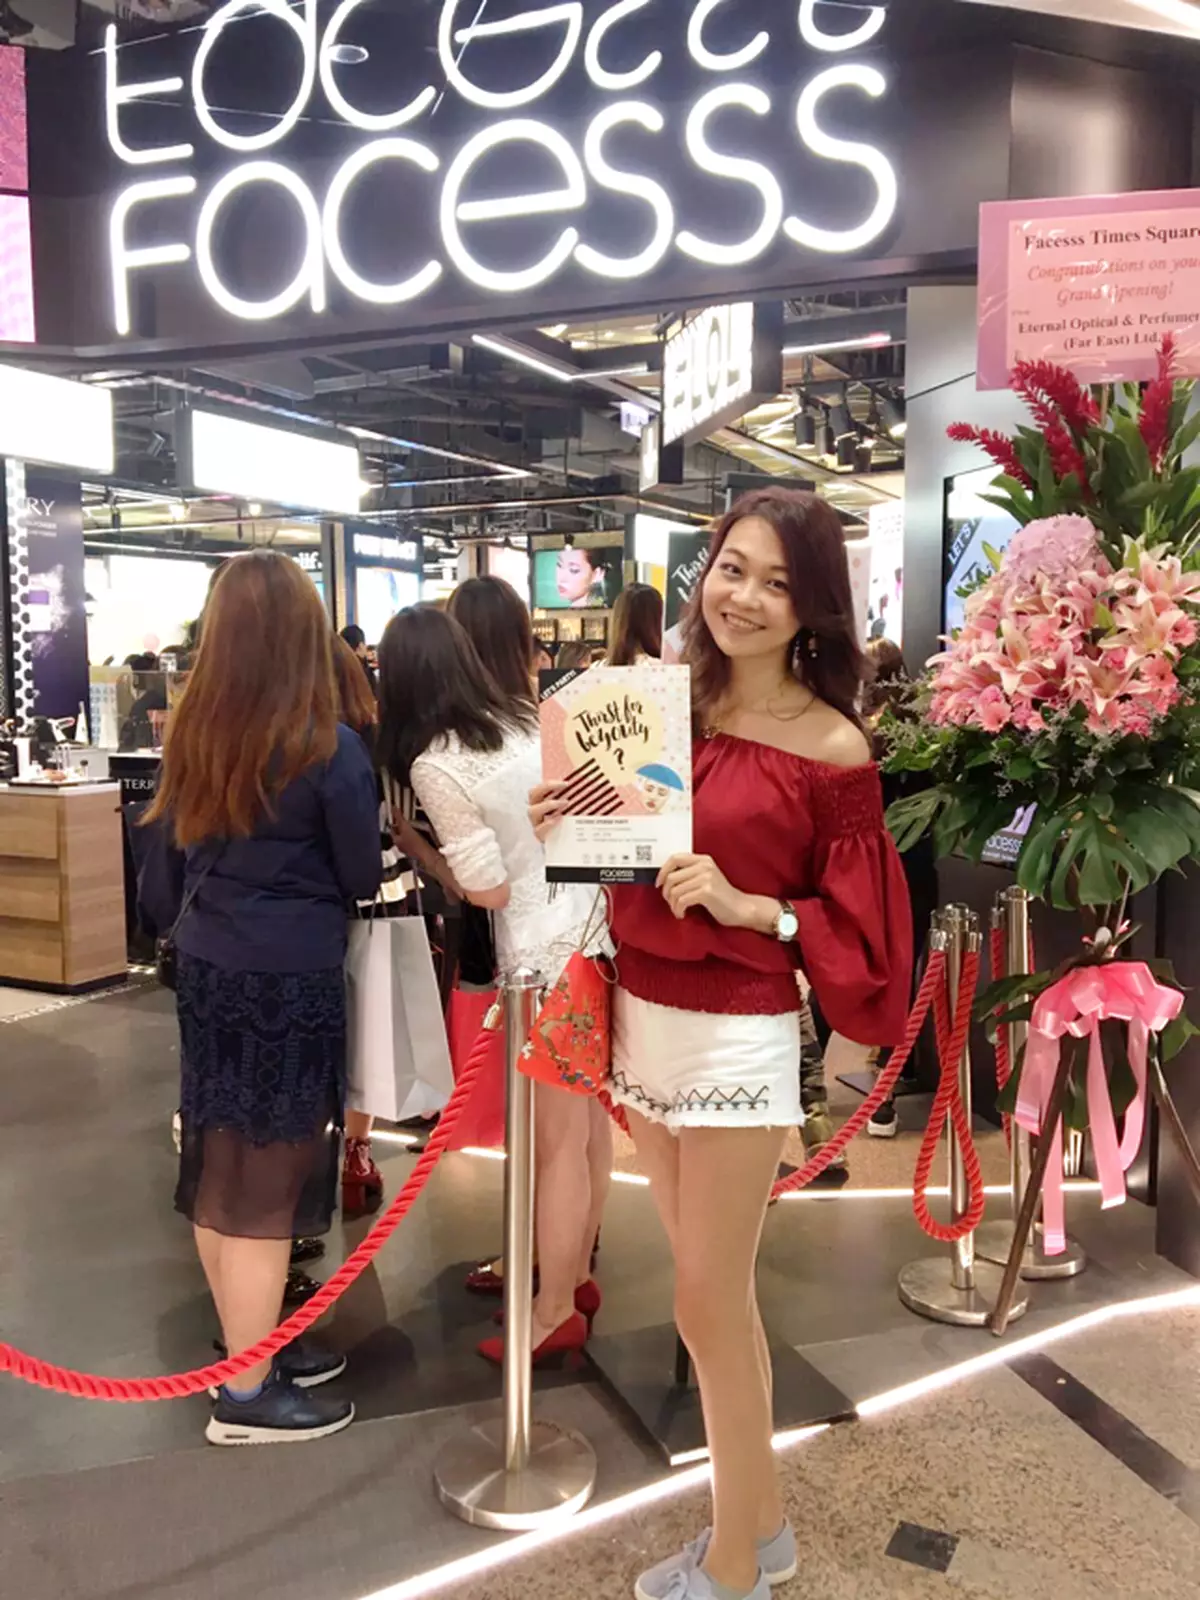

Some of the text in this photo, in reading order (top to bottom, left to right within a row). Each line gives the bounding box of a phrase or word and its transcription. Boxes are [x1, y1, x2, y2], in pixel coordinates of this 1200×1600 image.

[1024, 222, 1200, 251] Facesss Times Squar
[1027, 256, 1200, 282] Congratultions on you
[1018, 320, 1066, 334] Eternal
[1069, 315, 1118, 331] Optical
[1122, 315, 1133, 326] &
[1063, 331, 1161, 350] (Far East) Ltd.
[573, 694, 643, 733] Thirst for
